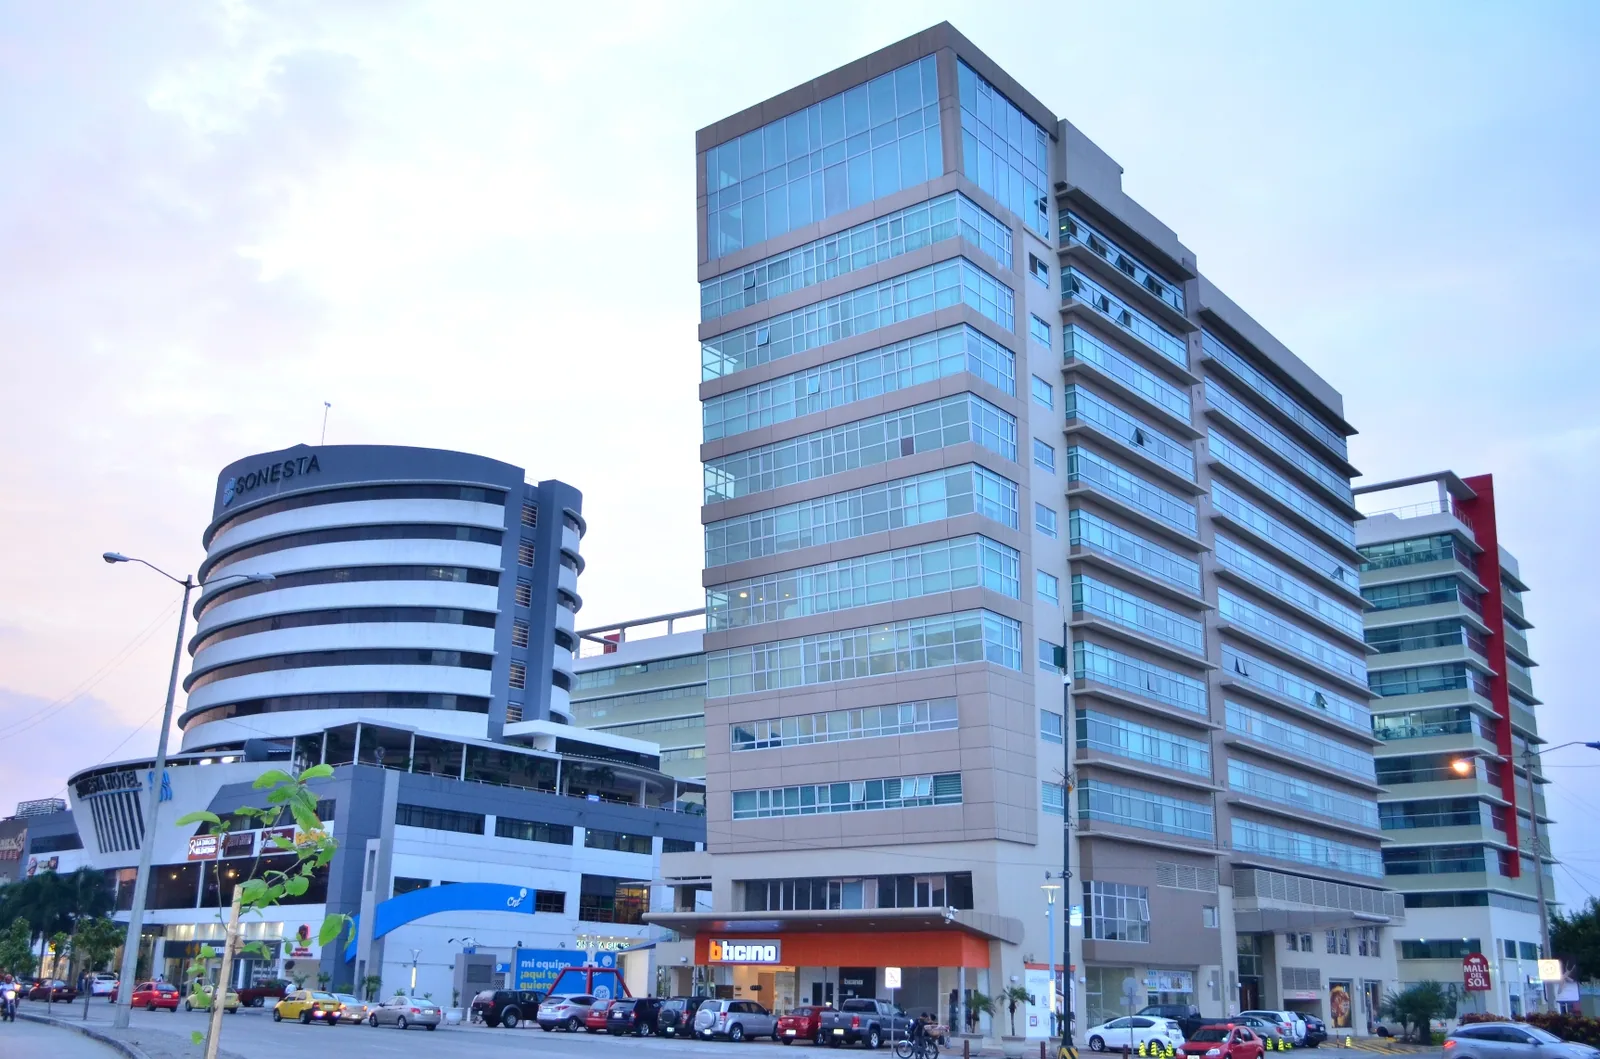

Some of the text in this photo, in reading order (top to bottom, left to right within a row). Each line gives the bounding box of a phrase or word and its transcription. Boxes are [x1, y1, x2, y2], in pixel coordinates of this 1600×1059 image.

[236, 454, 321, 494] SONESTA
[105, 770, 142, 791] HOTEL
[710, 940, 777, 961] bticino
[521, 958, 535, 968] mi
[536, 959, 571, 971] equipo
[1464, 964, 1488, 972] MALL
[1468, 978, 1488, 986] SOL
